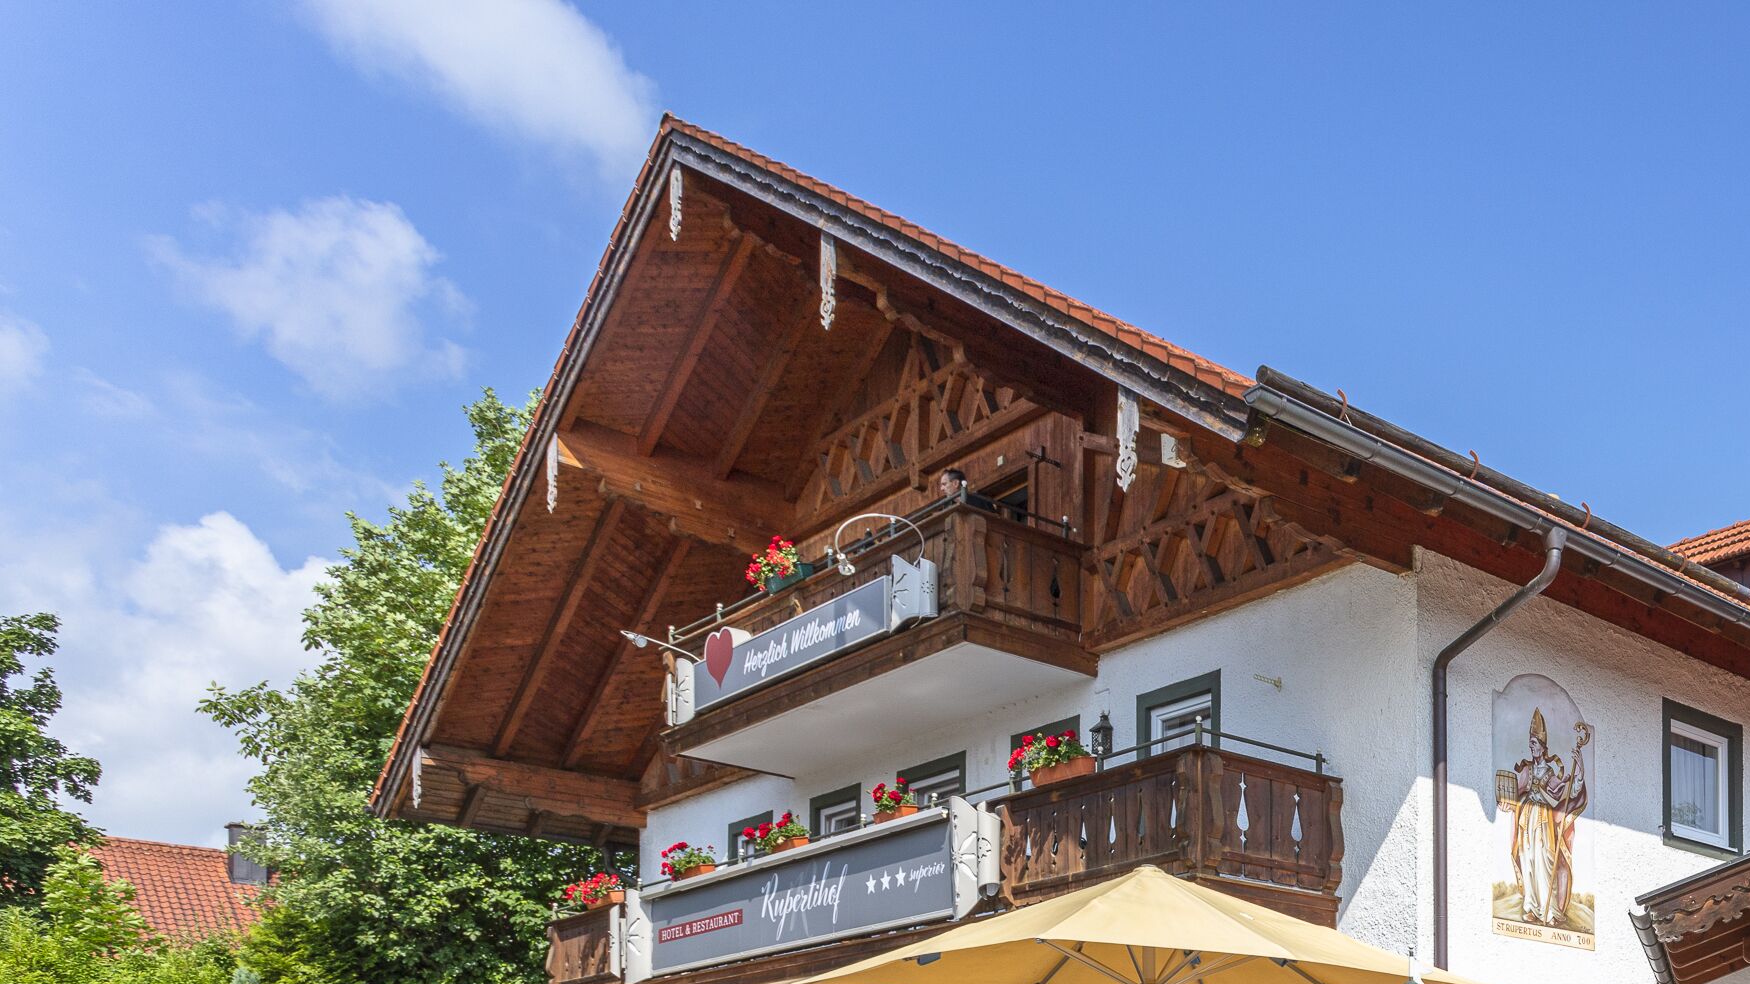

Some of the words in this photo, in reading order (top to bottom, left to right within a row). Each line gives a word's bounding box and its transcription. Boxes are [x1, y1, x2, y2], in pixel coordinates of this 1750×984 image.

[743, 632, 788, 677] Herzlich
[790, 609, 861, 655] Willkommen
[908, 861, 945, 893] superior
[761, 860, 848, 941] Rupertihof
[661, 925, 686, 942] HOTEL
[692, 913, 740, 934] RESTAURANT
[1551, 932, 1572, 942] ANNO
[1576, 935, 1591, 945] 700
